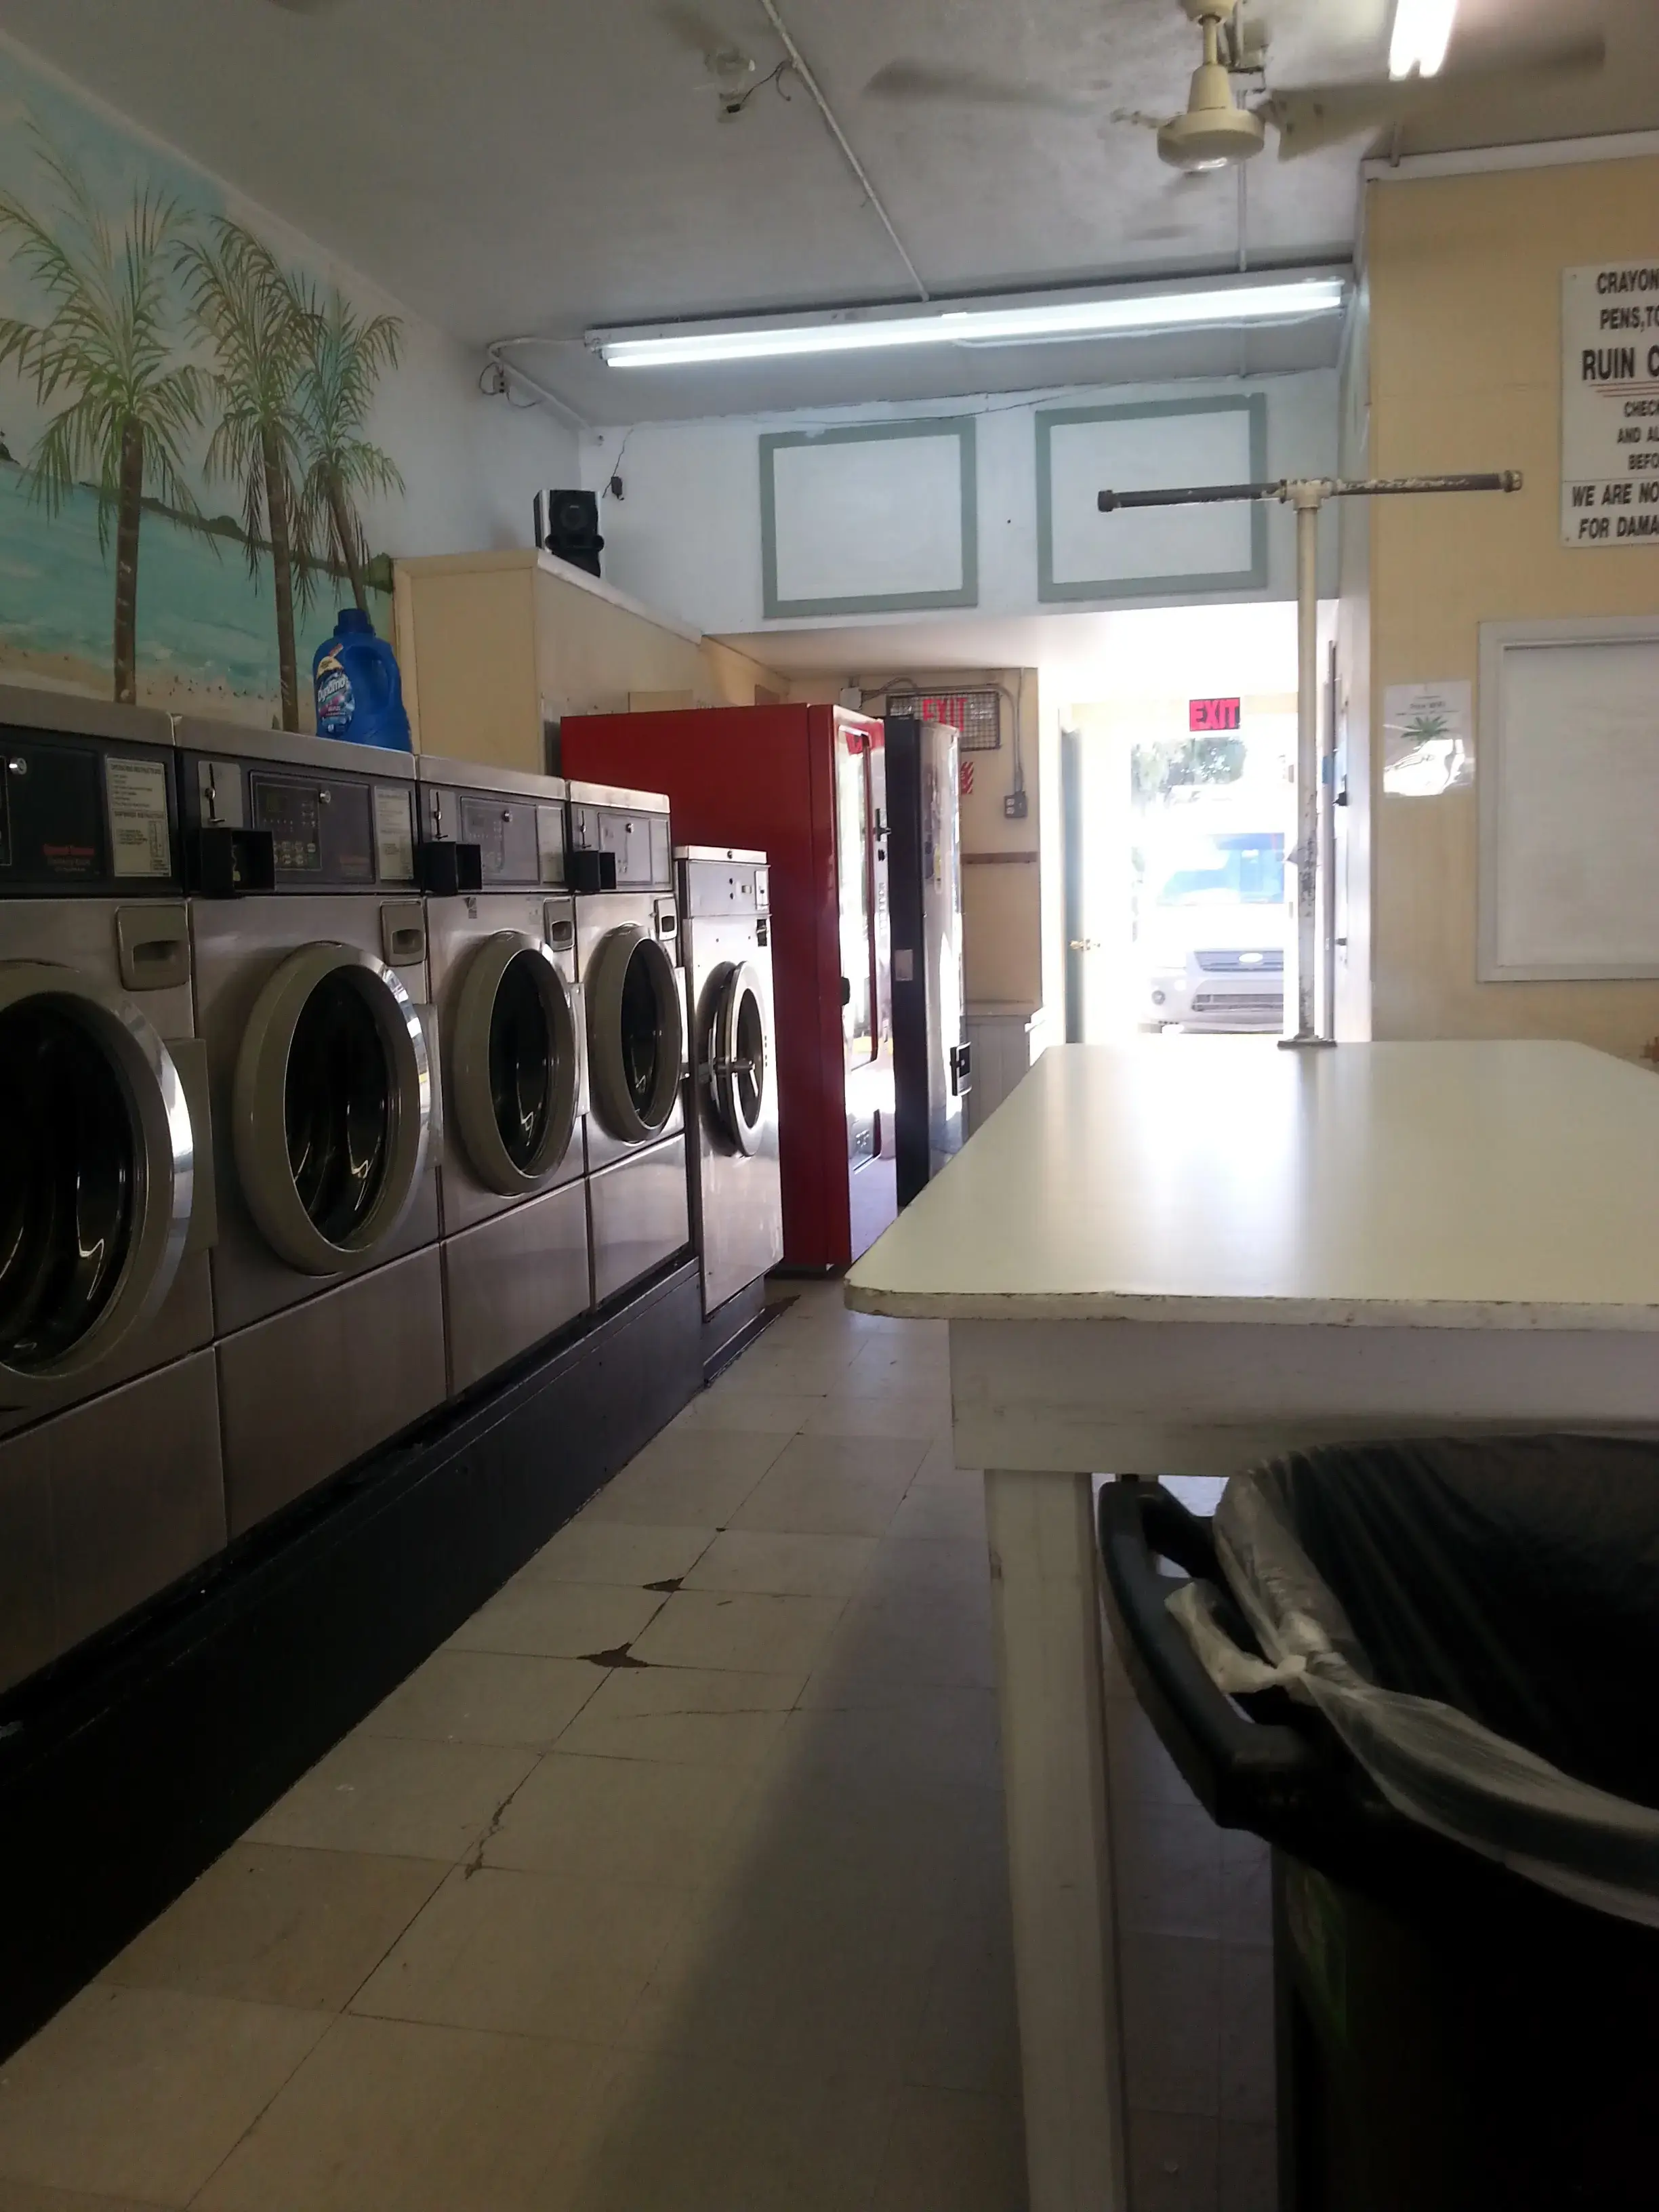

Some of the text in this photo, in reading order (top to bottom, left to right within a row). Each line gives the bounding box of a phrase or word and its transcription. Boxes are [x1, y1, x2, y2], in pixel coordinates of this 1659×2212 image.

[1597, 268, 1659, 294] CRAYON
[1582, 347, 1635, 380] RUIN
[1618, 426, 1641, 444] AND
[1572, 485, 1596, 507] WE
[1601, 483, 1633, 506] ARE
[1578, 516, 1610, 539] FOR
[922, 697, 968, 732] EXIT
[1190, 698, 1240, 731] EXIT
